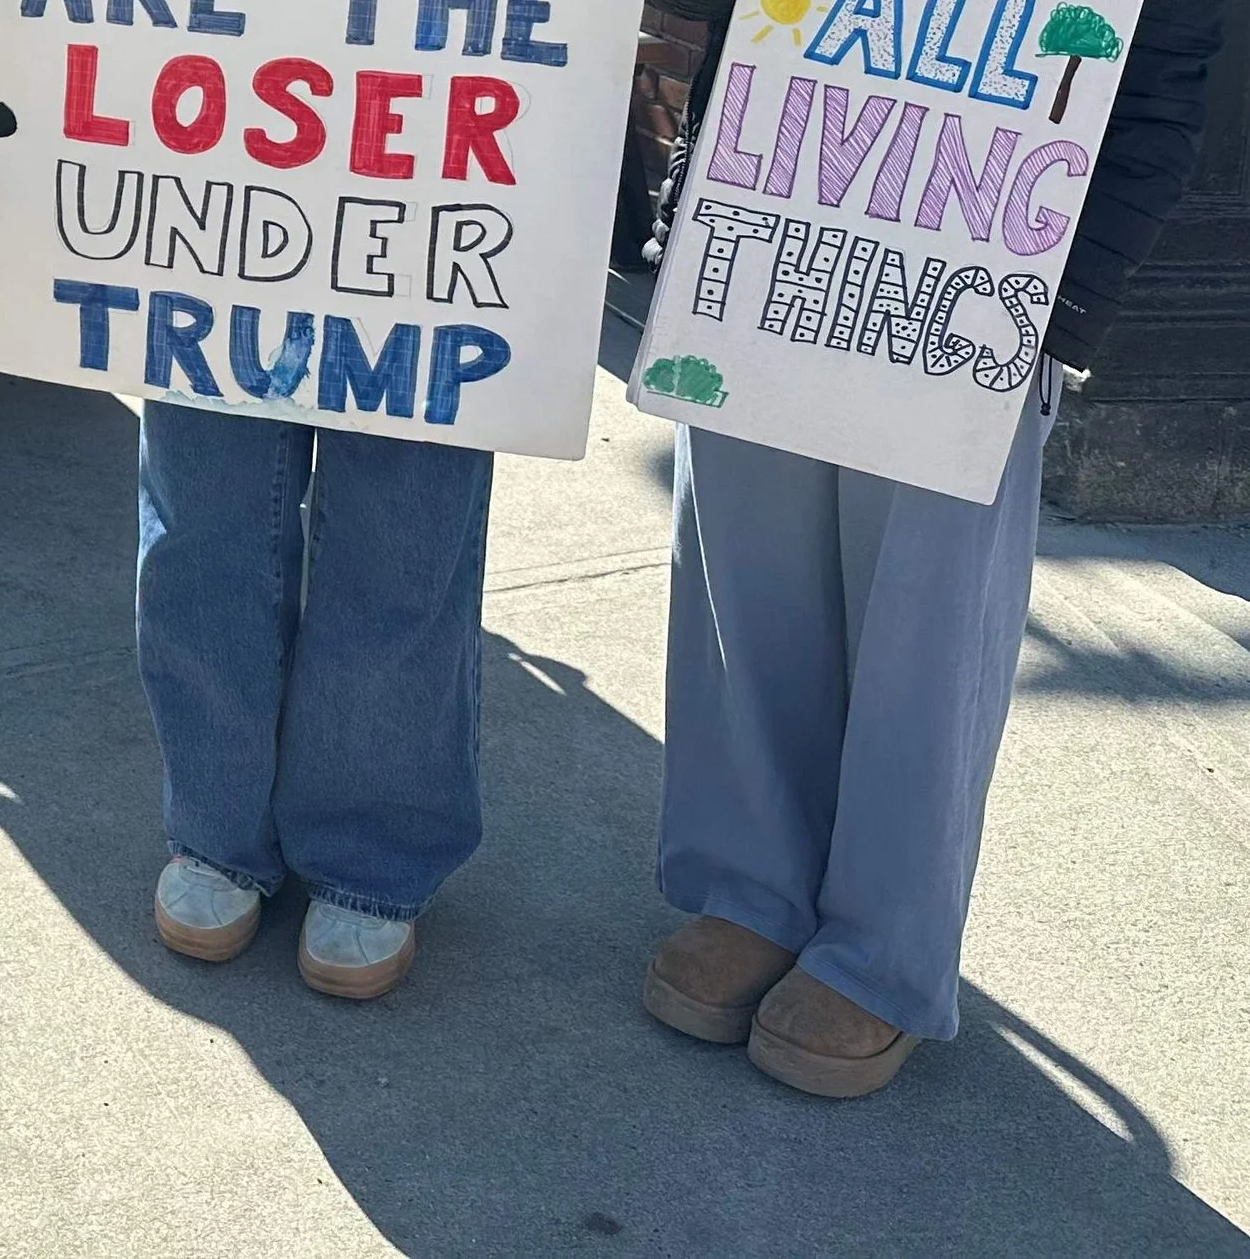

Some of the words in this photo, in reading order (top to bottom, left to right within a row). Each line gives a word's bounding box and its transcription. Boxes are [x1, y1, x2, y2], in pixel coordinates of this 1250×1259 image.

[63, 43, 521, 186] LOSER
[706, 62, 1090, 257] LIVING
[55, 159, 514, 309] UNDER
[692, 197, 1050, 393] THINGS
[53, 278, 512, 425] TRUMP
